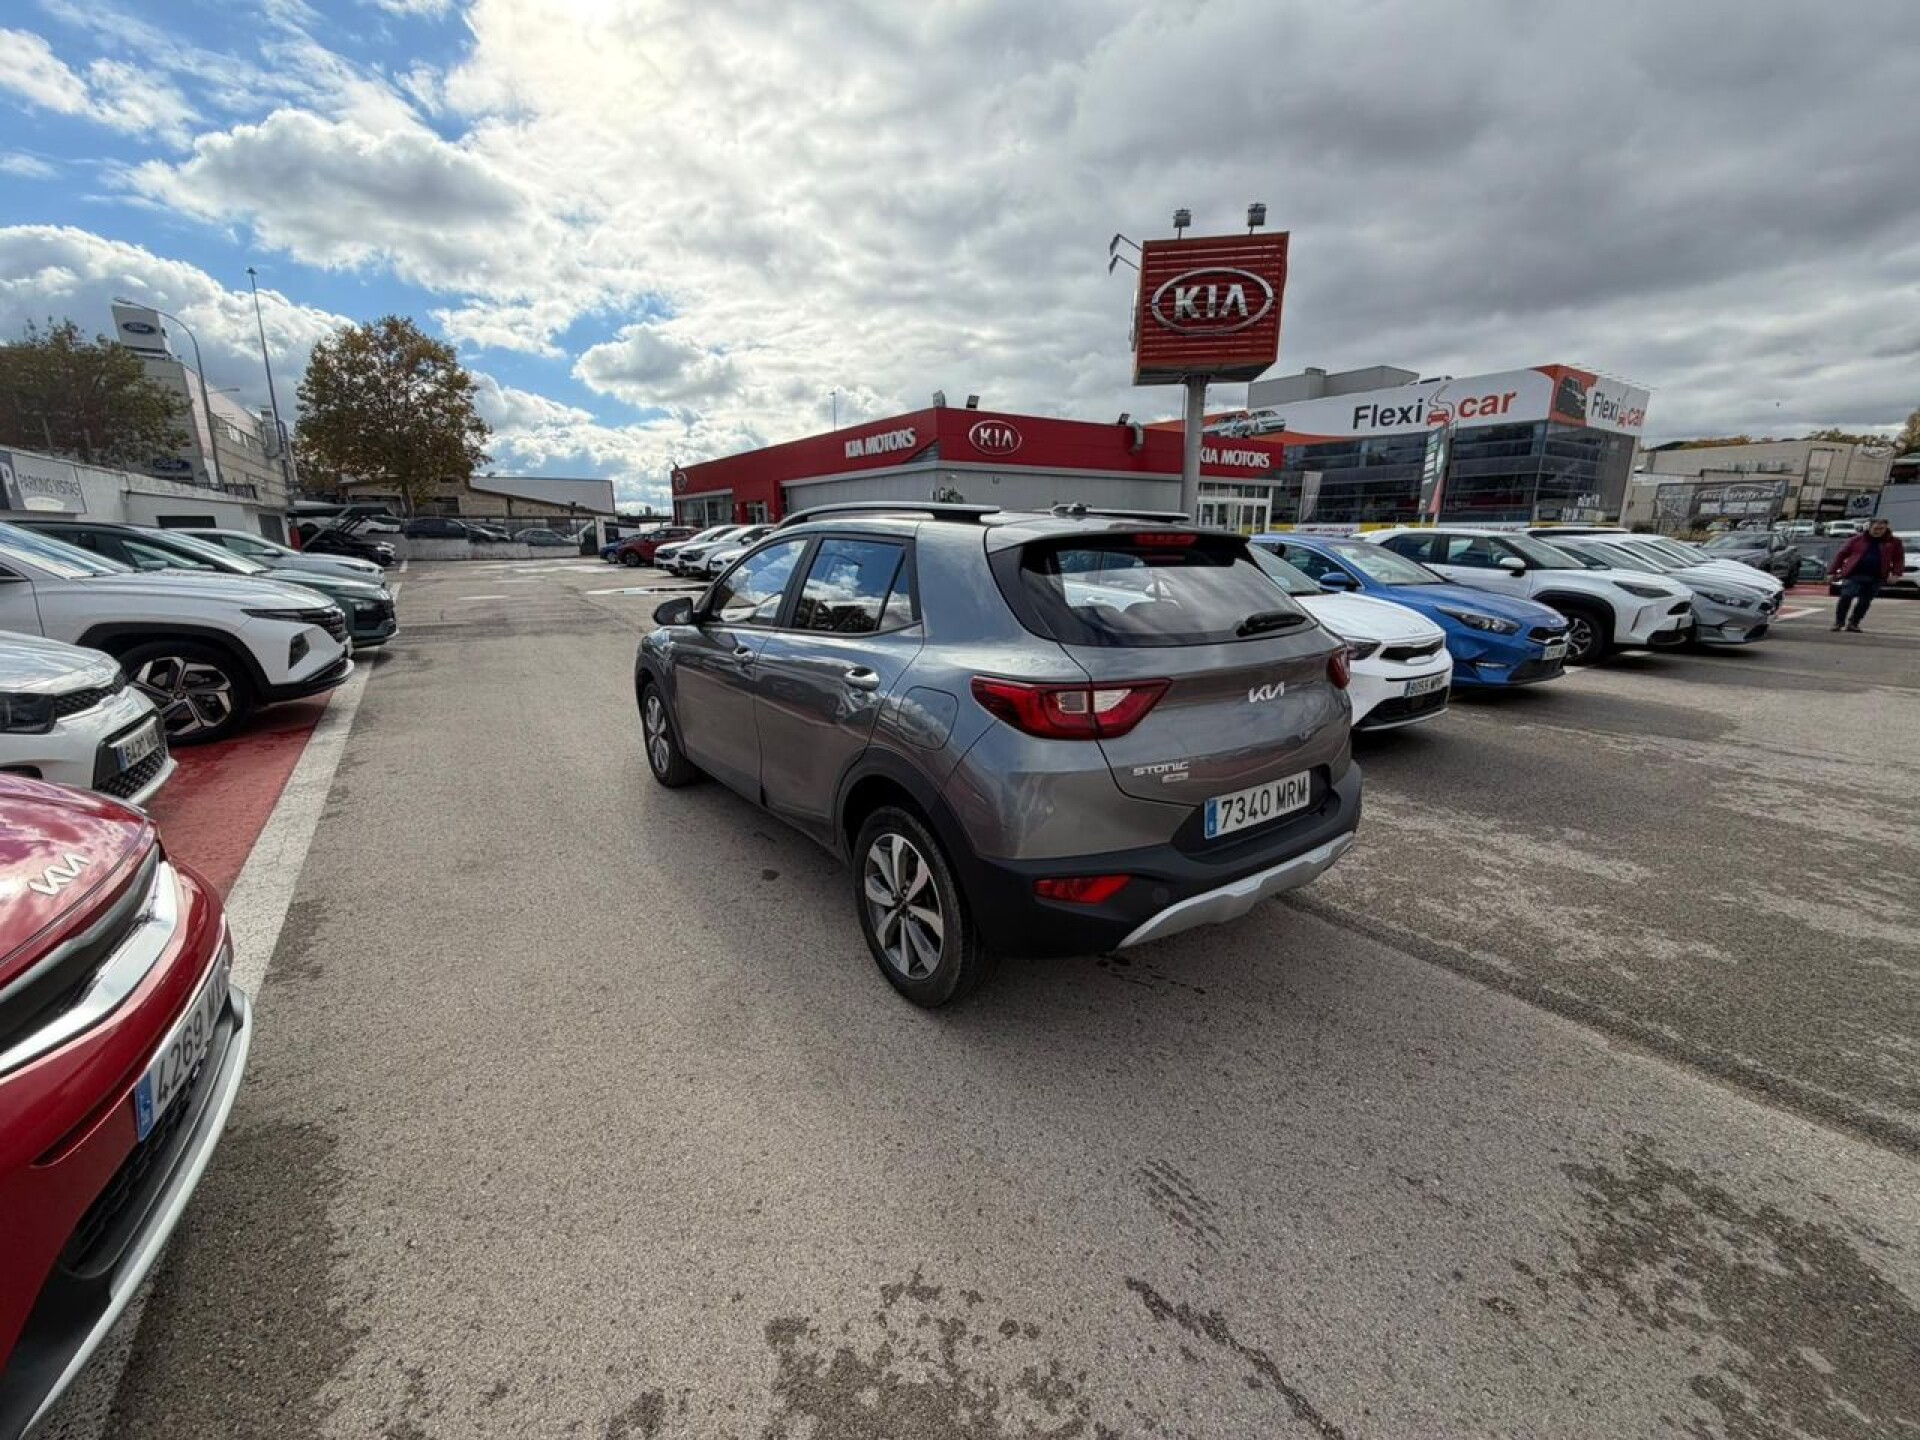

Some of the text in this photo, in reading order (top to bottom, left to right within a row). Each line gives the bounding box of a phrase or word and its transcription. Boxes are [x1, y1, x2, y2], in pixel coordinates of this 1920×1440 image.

[1174, 284, 1248, 321] KIA
[1353, 391, 1518, 430] Flexi car
[1591, 392, 1621, 421] Flexi
[845, 427, 916, 459] KIA MOTORS
[980, 427, 1014, 448] KIA
[1200, 447, 1270, 469] KIA MOTORS
[1248, 681, 1285, 703] KIA
[1133, 761, 1189, 777] STONIC
[1221, 777, 1307, 830] 7340 MRM
[27, 851, 90, 895] KIA
[156, 1010, 204, 1105] 4269
